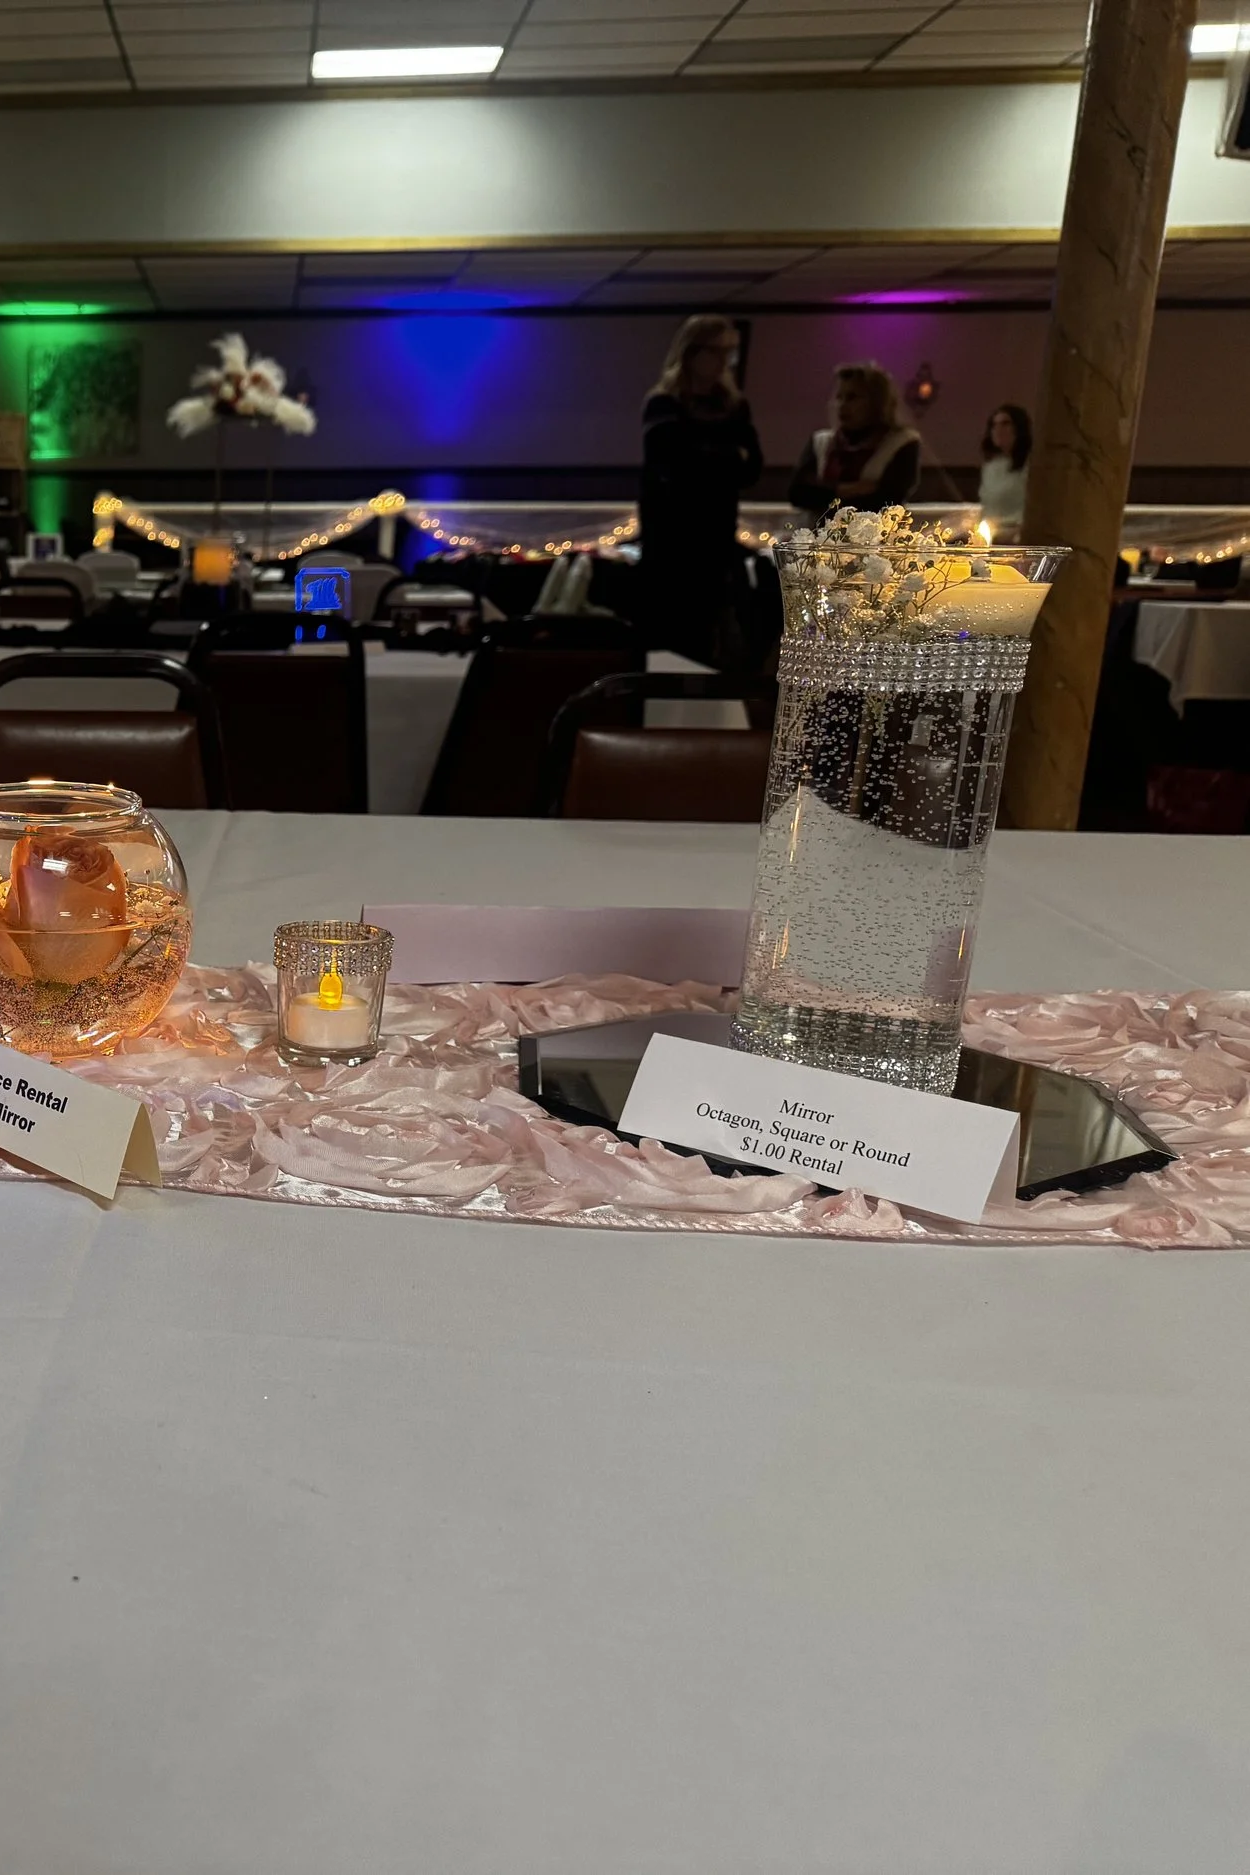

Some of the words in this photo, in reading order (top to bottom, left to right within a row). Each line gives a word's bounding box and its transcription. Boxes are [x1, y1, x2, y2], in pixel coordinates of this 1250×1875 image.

[15, 1078, 68, 1114] Rental
[778, 1099, 835, 1125] Mirror
[696, 1102, 764, 1134] Octagon,
[769, 1120, 825, 1147] Square
[829, 1138, 849, 1152] or
[851, 1140, 911, 1168] Round
[740, 1136, 785, 1160] $1.00
[789, 1149, 844, 1176] Rental
